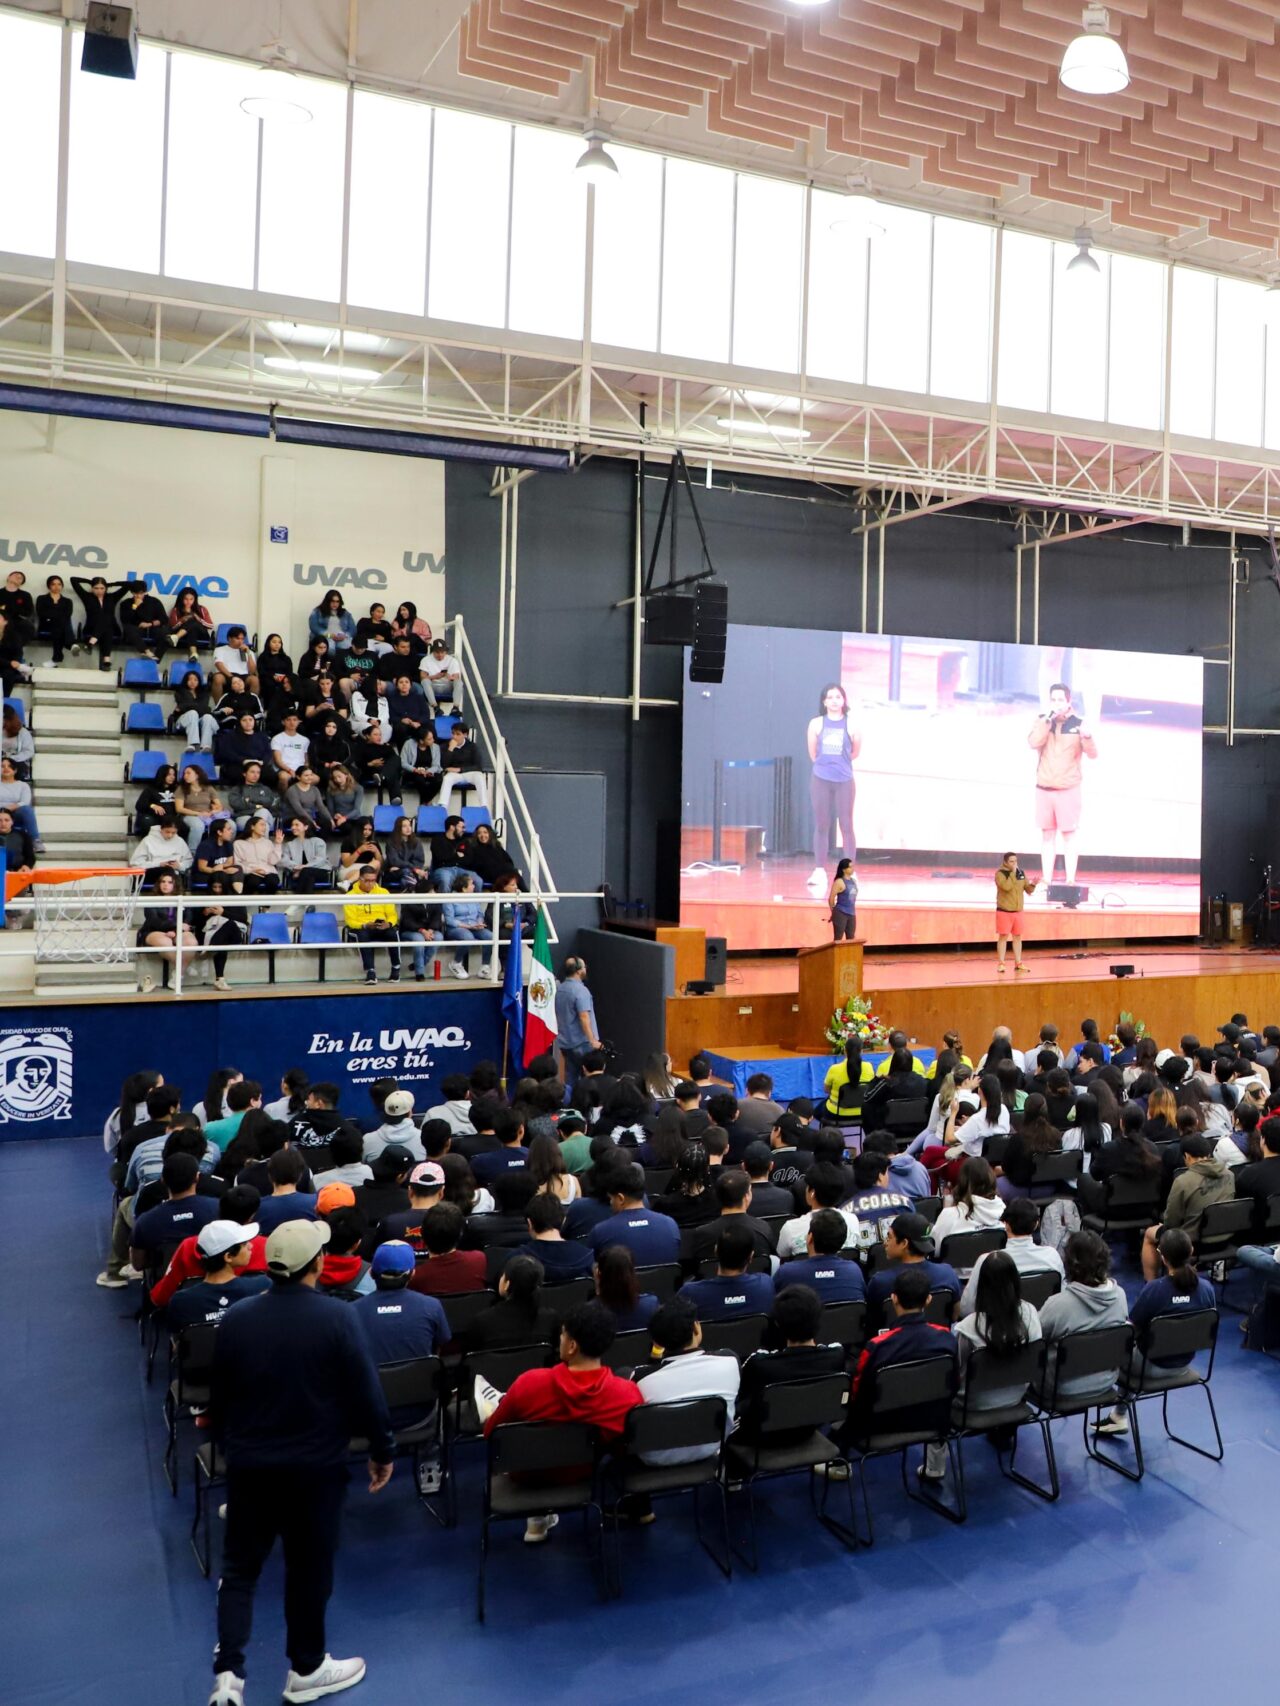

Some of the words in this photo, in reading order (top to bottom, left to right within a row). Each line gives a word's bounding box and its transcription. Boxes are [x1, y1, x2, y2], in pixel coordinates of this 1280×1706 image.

[0, 539, 109, 569] UVAQ
[402, 551, 445, 574] UV
[293, 564, 388, 590] UVAQ
[307, 1033, 345, 1054] En
[350, 1032, 373, 1052] la
[379, 1026, 472, 1051] UVAQ,
[346, 1055, 398, 1072] eres
[403, 1048, 434, 1068] tú.
